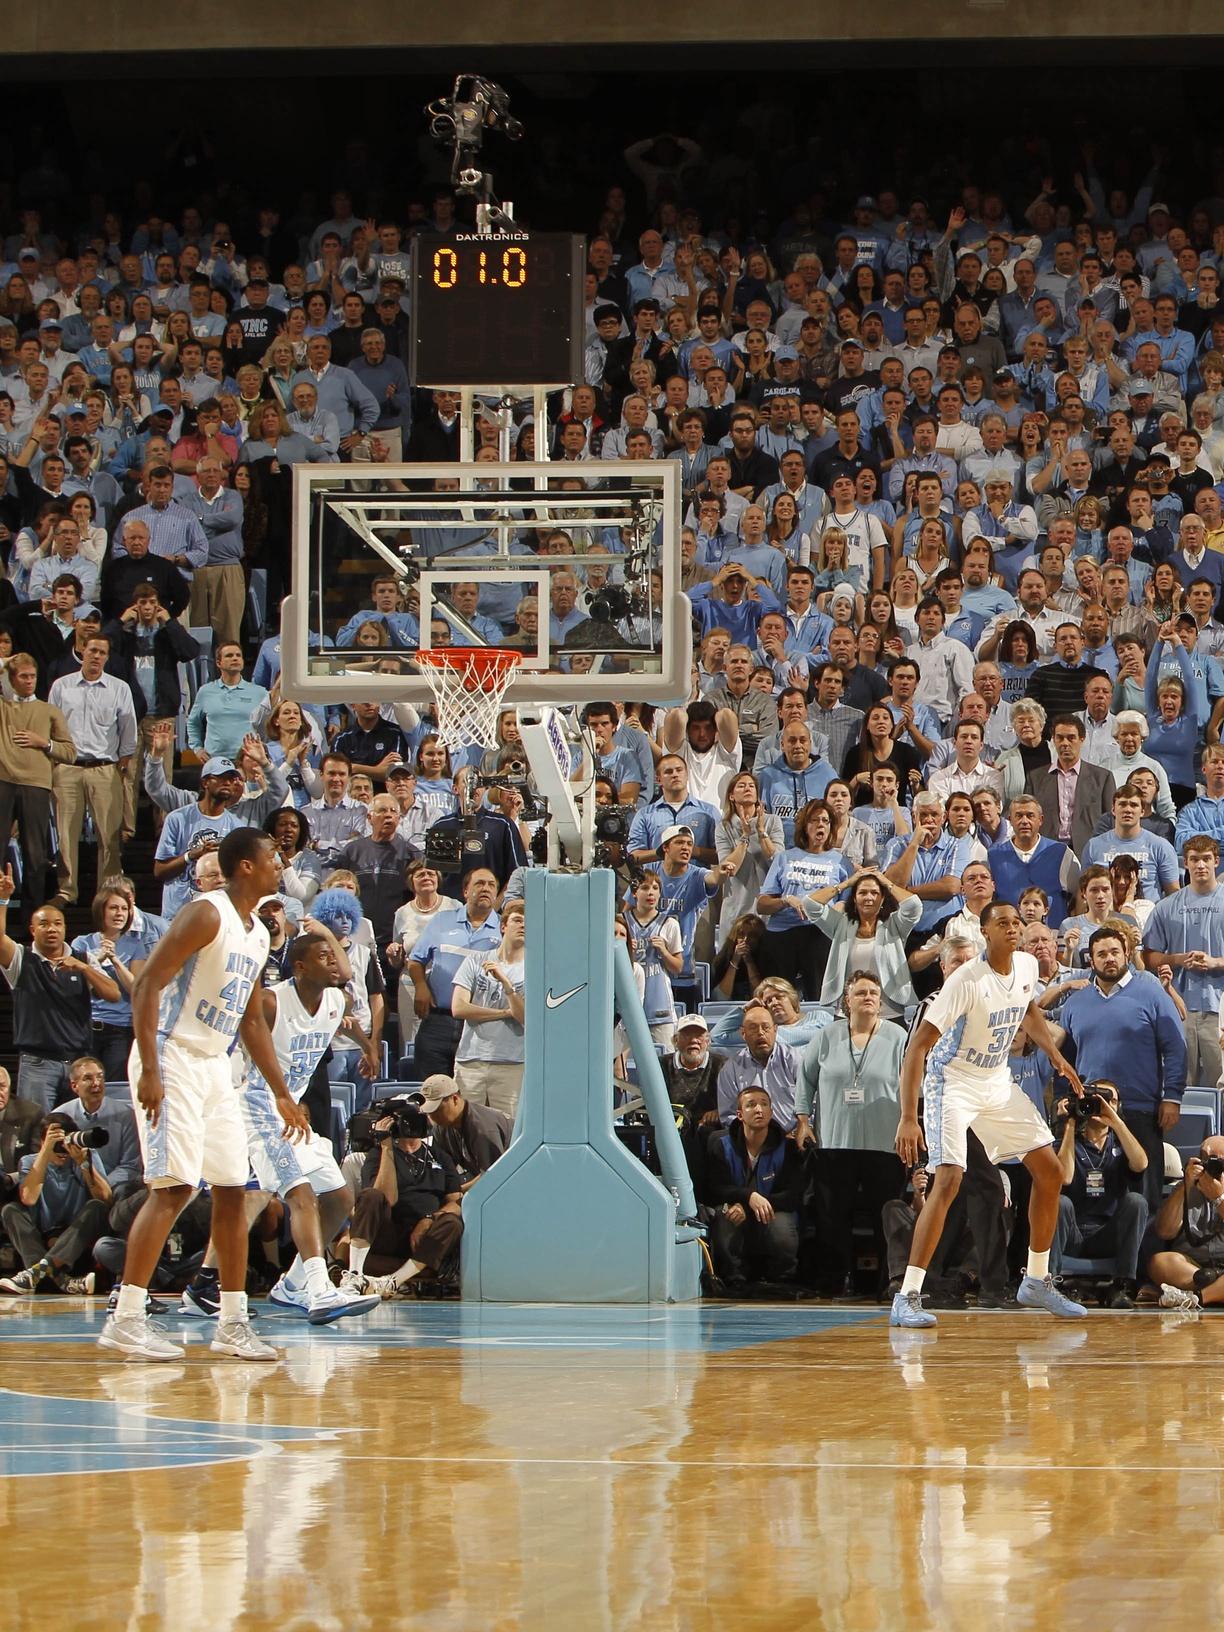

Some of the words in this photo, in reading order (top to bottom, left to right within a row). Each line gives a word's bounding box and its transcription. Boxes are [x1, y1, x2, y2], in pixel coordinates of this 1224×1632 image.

[456, 233, 529, 241] DAKTRONICS
[433, 247, 526, 288] 01.0
[763, 387, 800, 398] CAROLINA
[793, 866, 808, 875] WE
[808, 868, 827, 877] ARE
[660, 898, 684, 912] ORTH
[219, 980, 251, 1014] 40
[196, 999, 241, 1036] CARO
[290, 1032, 331, 1052] NORTH
[988, 1025, 1016, 1053] 31
